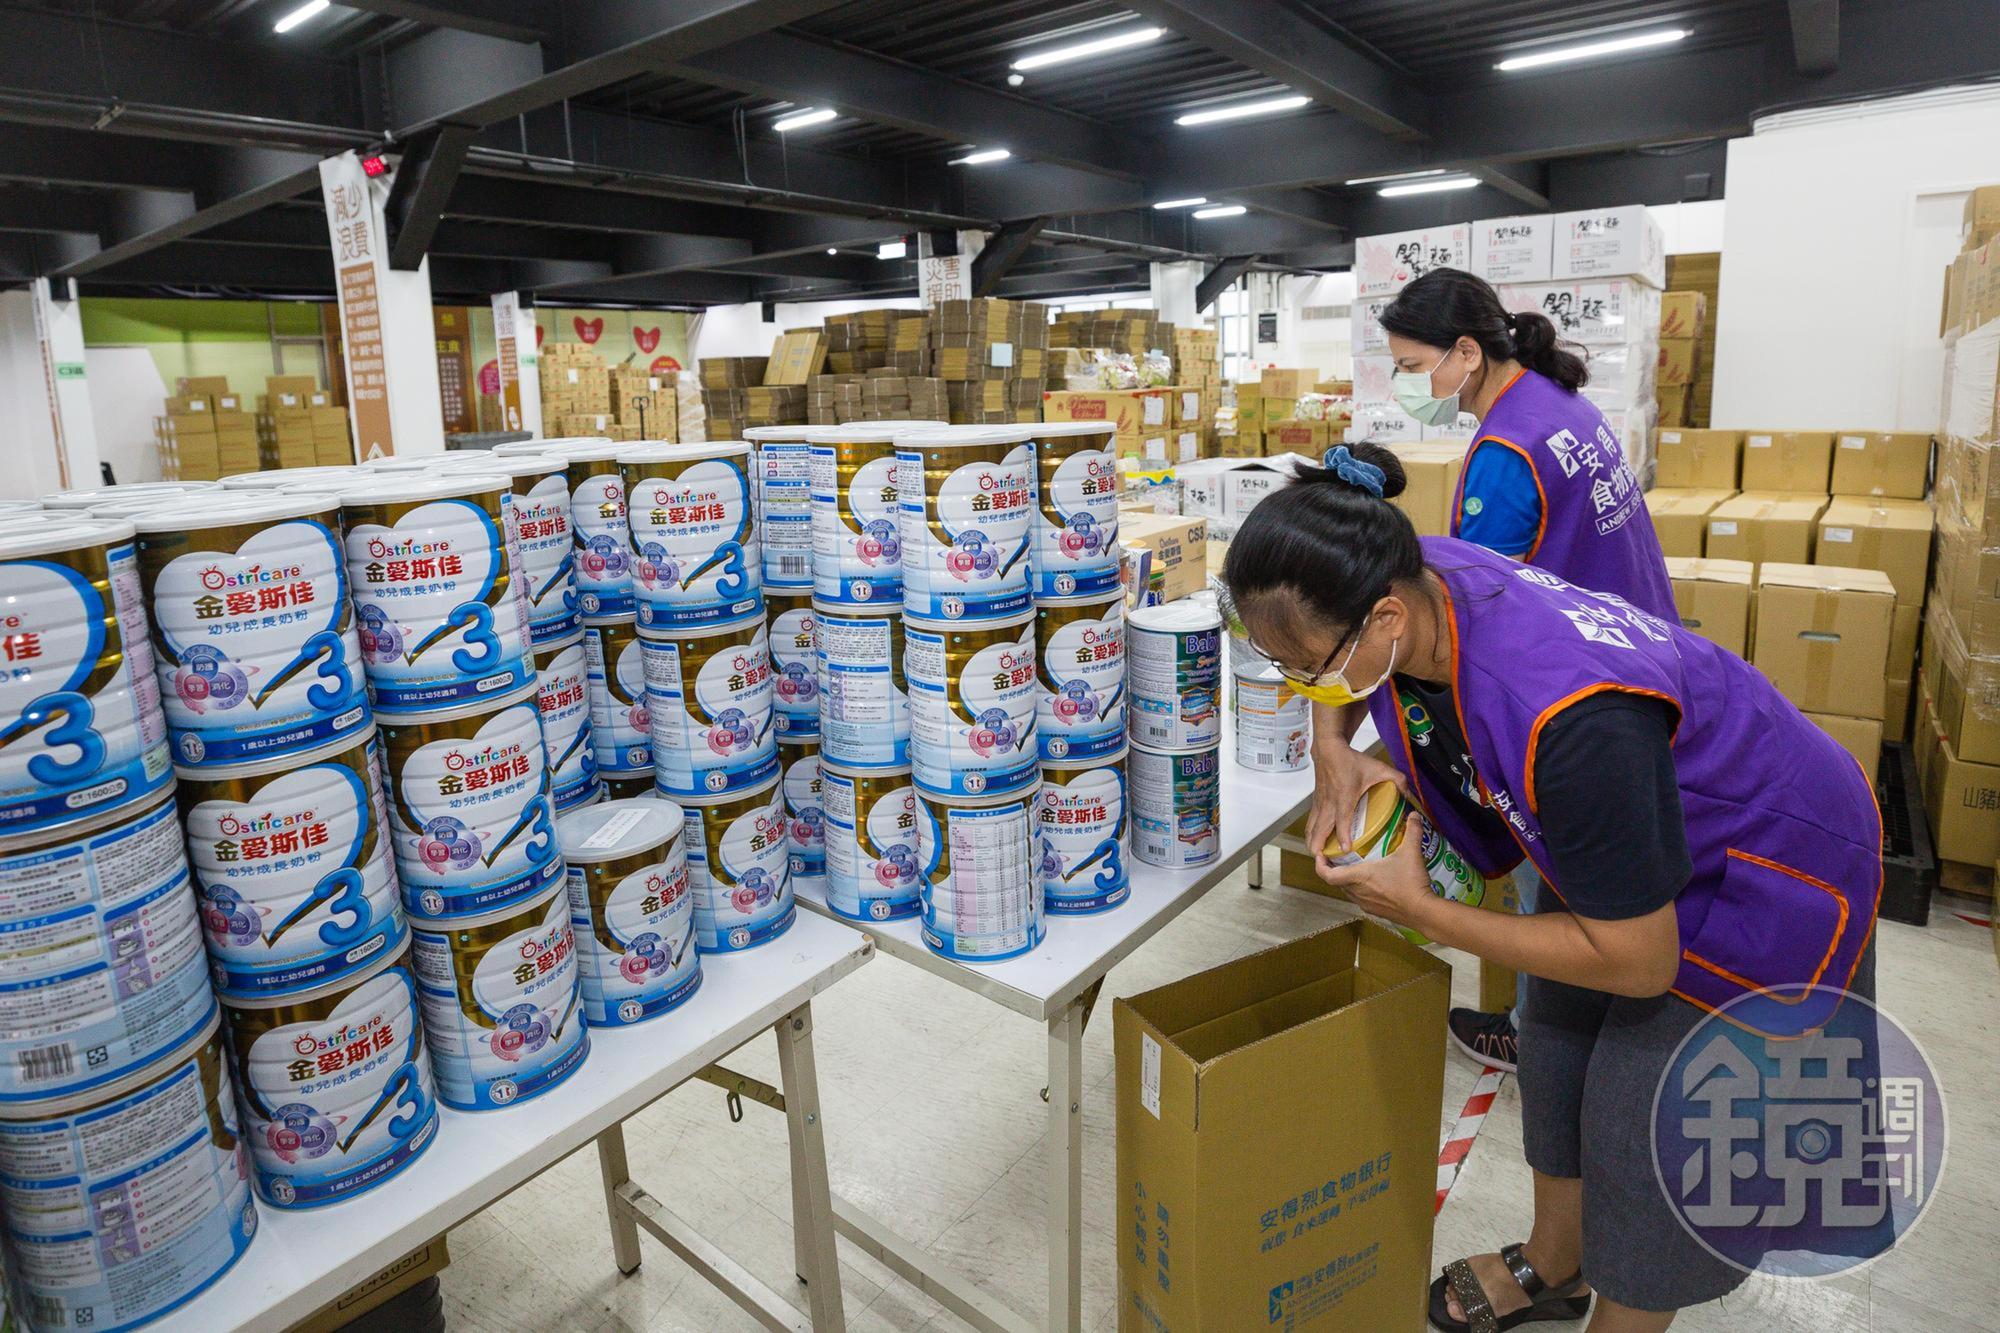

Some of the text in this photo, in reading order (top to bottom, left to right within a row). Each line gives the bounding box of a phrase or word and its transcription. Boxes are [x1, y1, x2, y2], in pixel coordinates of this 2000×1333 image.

[926, 256, 960, 281] 災害
[654, 489, 717, 505] Ostricare
[650, 503, 725, 525] 金愛斯佳
[657, 524, 720, 537] 幼兒成長奶粉
[1188, 526, 1205, 544] CS3
[368, 537, 449, 559] Ostricare
[199, 564, 301, 591] Ostricare
[365, 555, 463, 583] 金愛斯佳
[713, 541, 749, 599] 3
[193, 581, 315, 619] 金愛斯佳
[374, 580, 457, 598] 幼兒成長奶粉
[208, 609, 308, 636] 幼兒成長奶粉
[448, 600, 502, 674] 3
[300, 630, 353, 711] 3
[399, 688, 458, 701] 1歲以上幼兒適用
[21, 691, 107, 786] 3
[241, 729, 314, 751] 1歲以上幼兒適用
[444, 745, 521, 771] Ostricare
[438, 755, 530, 796] 金愛斯佳
[86, 783, 125, 801] 1600公克
[449, 779, 526, 808] 幼兒成長奶粉
[1045, 791, 1100, 806] Ostricare
[217, 810, 314, 836] Ostricare
[520, 794, 560, 863] 3
[1041, 806, 1107, 824] 金愛斯佳
[214, 822, 329, 862] 金愛斯佳
[225, 852, 322, 877] 幼兒成長奶粉
[1094, 838, 1123, 891] 3
[475, 880, 531, 903] 1歲以上幼兒適用
[313, 867, 373, 946] 3
[257, 964, 325, 985] 1歲以上幼兒適用
[294, 1015, 381, 1055] Ostricare
[287, 1024, 394, 1083] 金愛斯佳
[300, 1051, 389, 1095] 幼兒成長奶粉
[382, 1061, 425, 1138] 3
[329, 1157, 394, 1192] 1歲以上幼兒適用
[1260, 1151, 1392, 1233] 安得烈食物銀行
